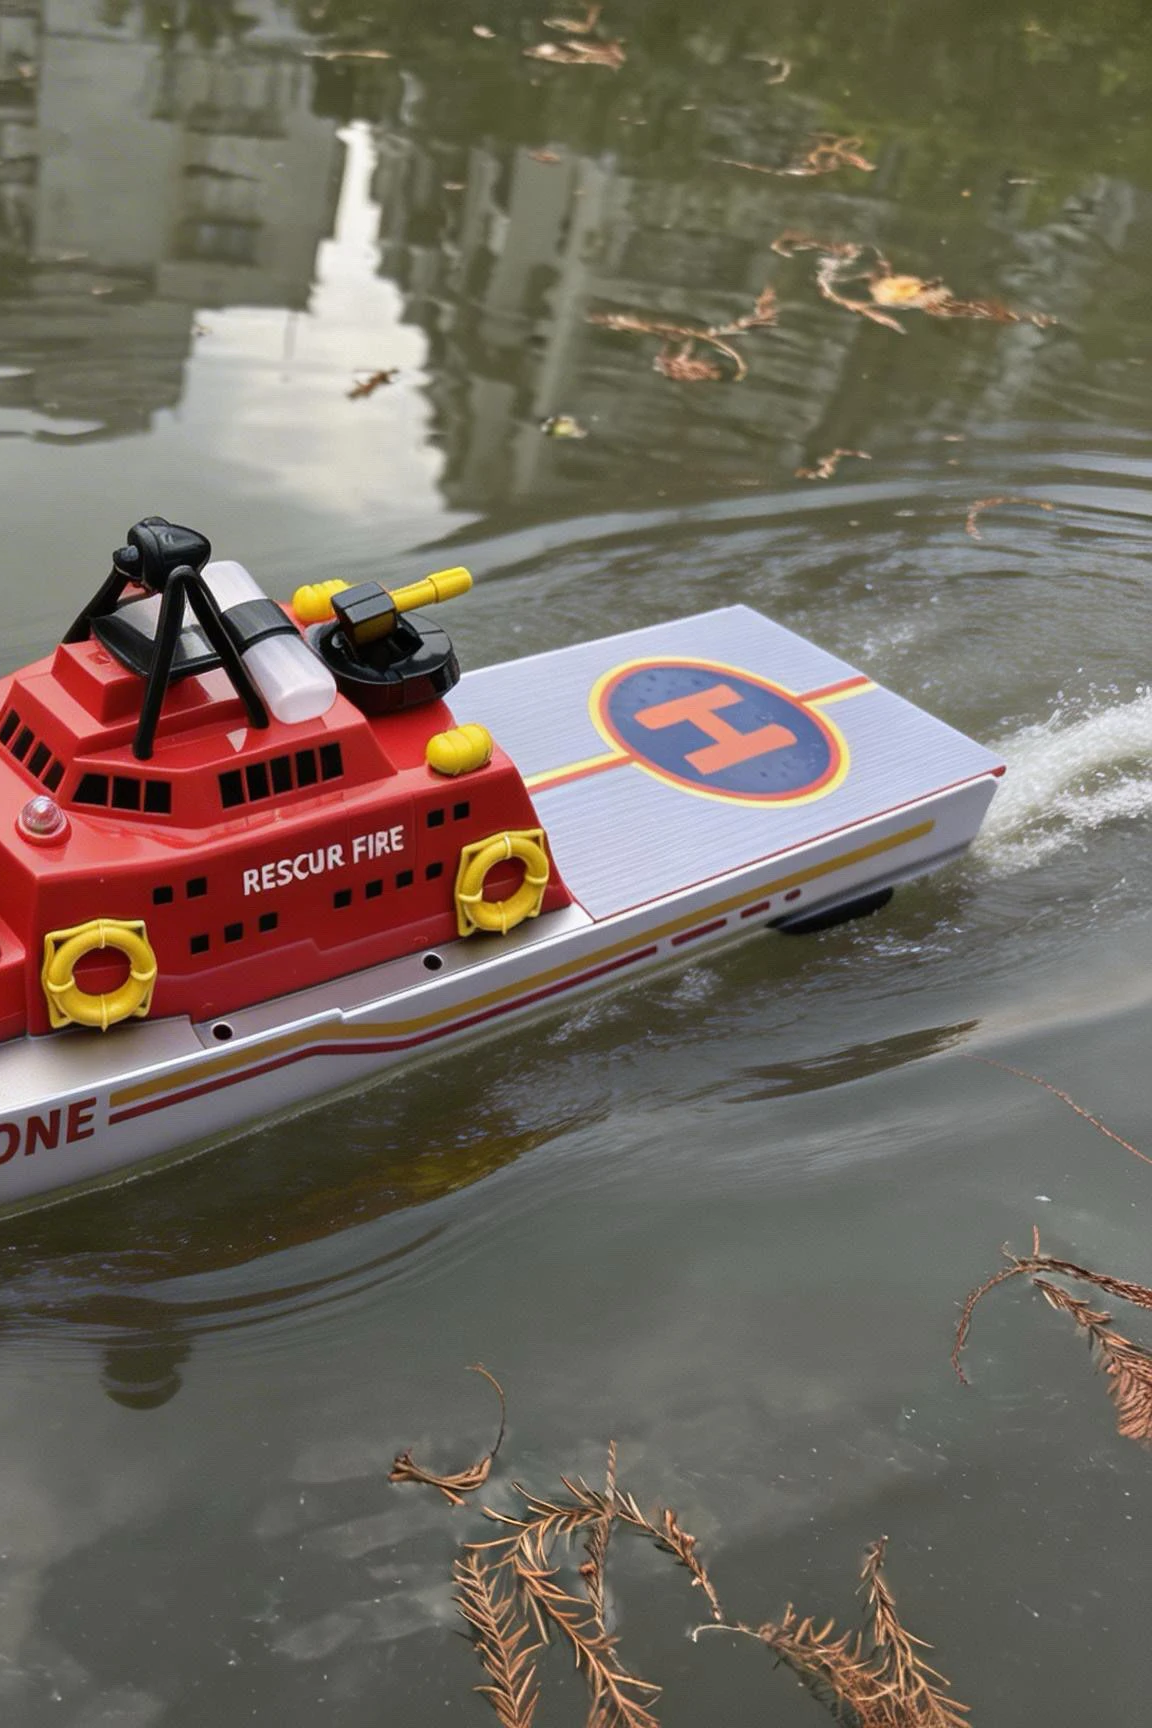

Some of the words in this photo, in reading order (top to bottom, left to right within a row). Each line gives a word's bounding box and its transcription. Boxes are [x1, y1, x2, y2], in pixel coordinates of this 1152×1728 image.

[633, 684, 798, 775] H
[243, 843, 346, 896] RESCUR
[352, 824, 405, 864] FIRE
